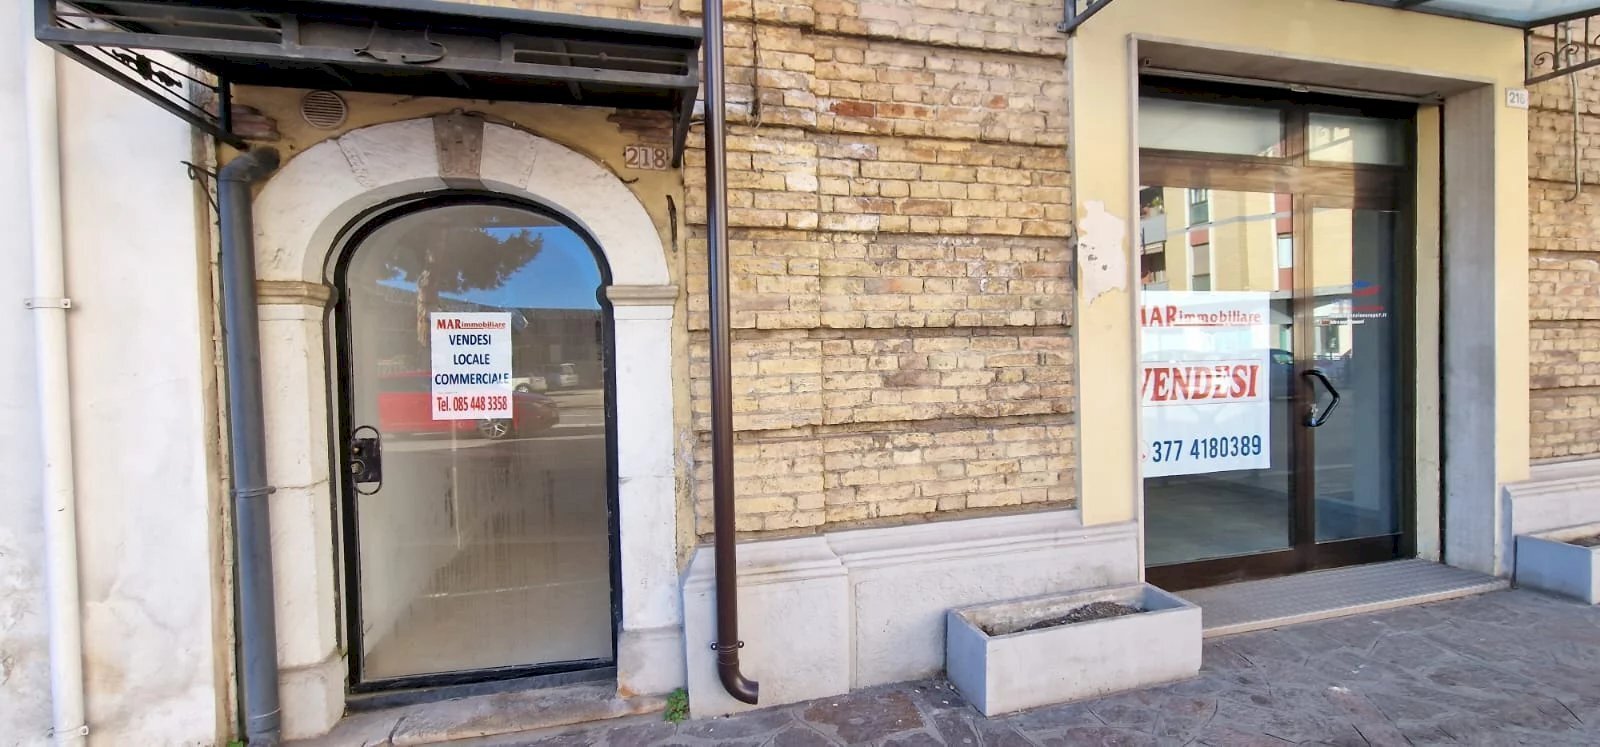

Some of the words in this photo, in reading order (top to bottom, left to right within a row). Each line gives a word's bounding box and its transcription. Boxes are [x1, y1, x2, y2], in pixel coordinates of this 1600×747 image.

[1509, 91, 1526, 105] 216
[627, 147, 666, 168] 218
[449, 334, 491, 346] VENDESI
[453, 353, 491, 365] LOCALE
[435, 372, 509, 385] COMMERCIALE
[437, 396, 451, 411] Tel.
[453, 396, 469, 411] 085
[470, 396, 486, 411] 448
[487, 395, 508, 411] 3358
[1152, 440, 1184, 463] 377
[1189, 434, 1262, 460] 4180389
